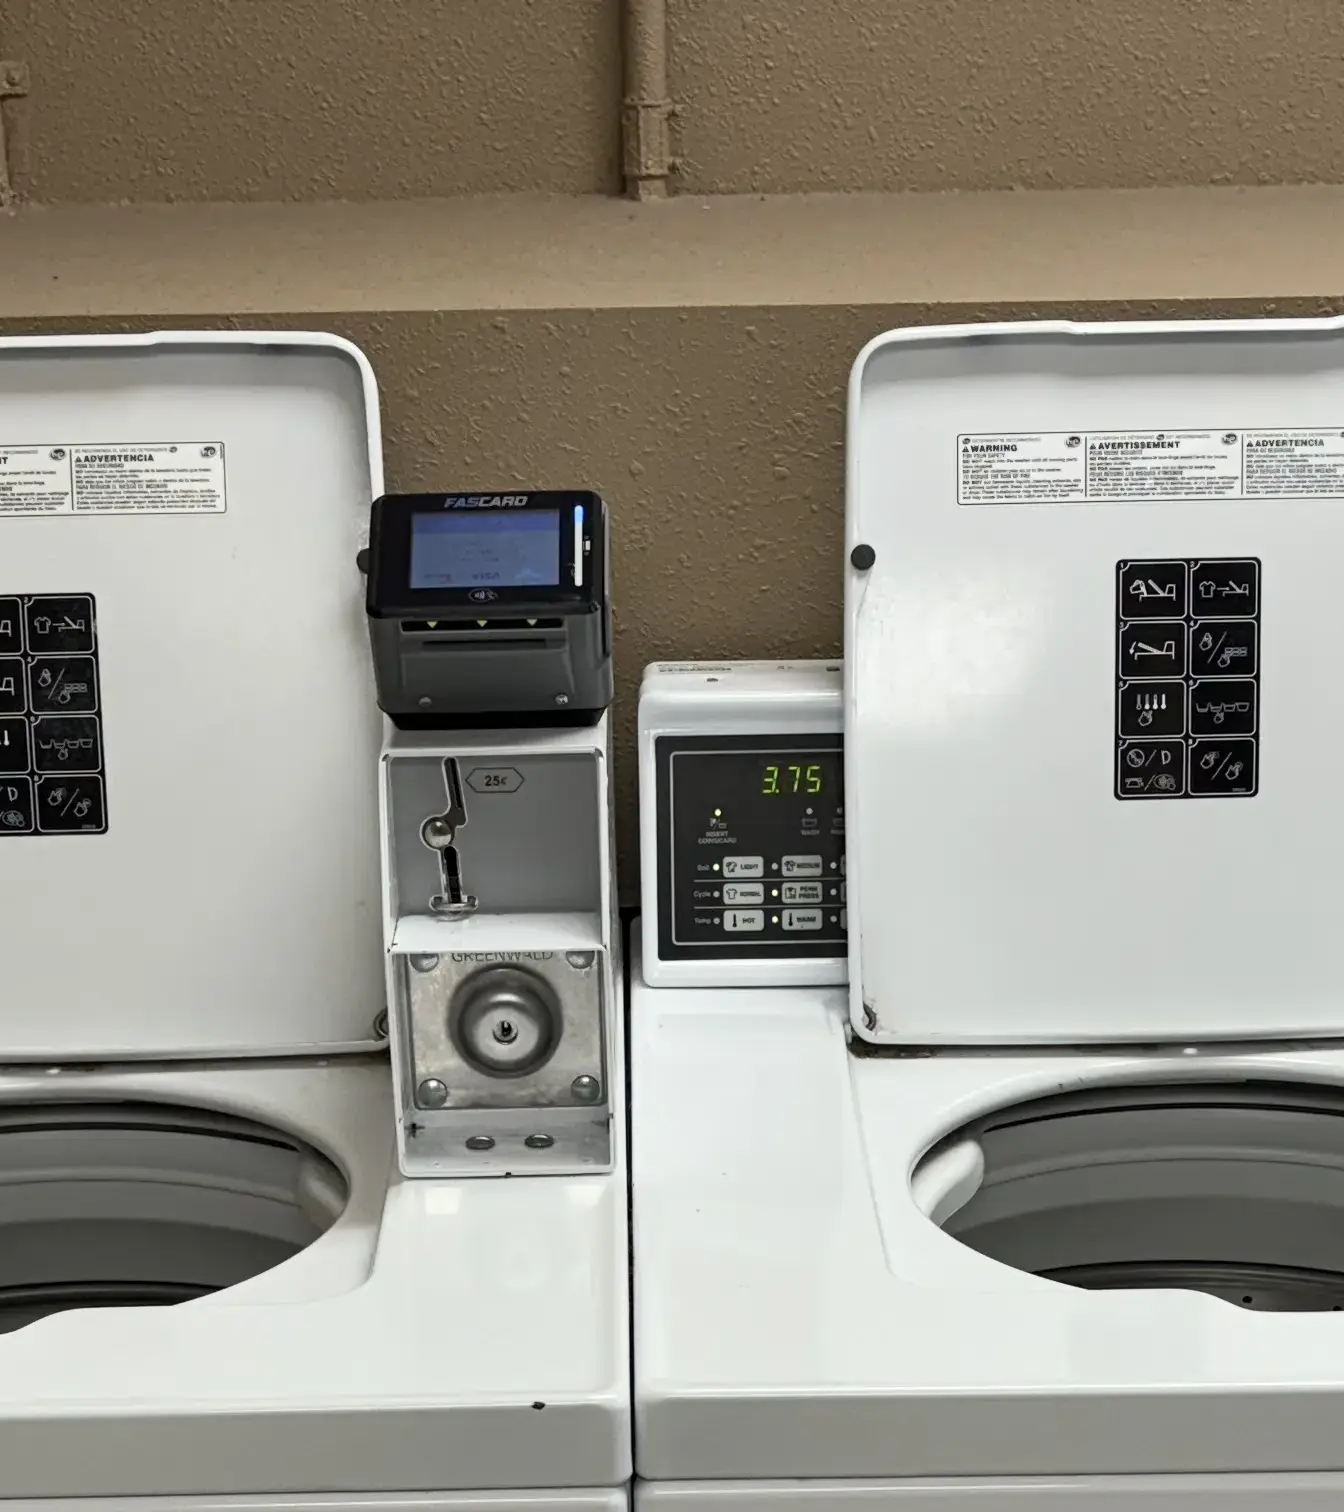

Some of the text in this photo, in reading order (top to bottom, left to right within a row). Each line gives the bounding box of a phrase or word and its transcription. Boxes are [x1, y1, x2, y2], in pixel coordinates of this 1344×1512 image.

[1098, 441, 1181, 449] AVERTISSEMENT
[1255, 438, 1325, 447] ADVERTENCIA
[970, 444, 1018, 452] WARNING
[83, 453, 155, 462] ADVERTENCIA
[444, 496, 528, 508] FASCARD
[762, 766, 821, 793] 3.75
[693, 891, 711, 899] Cycle
